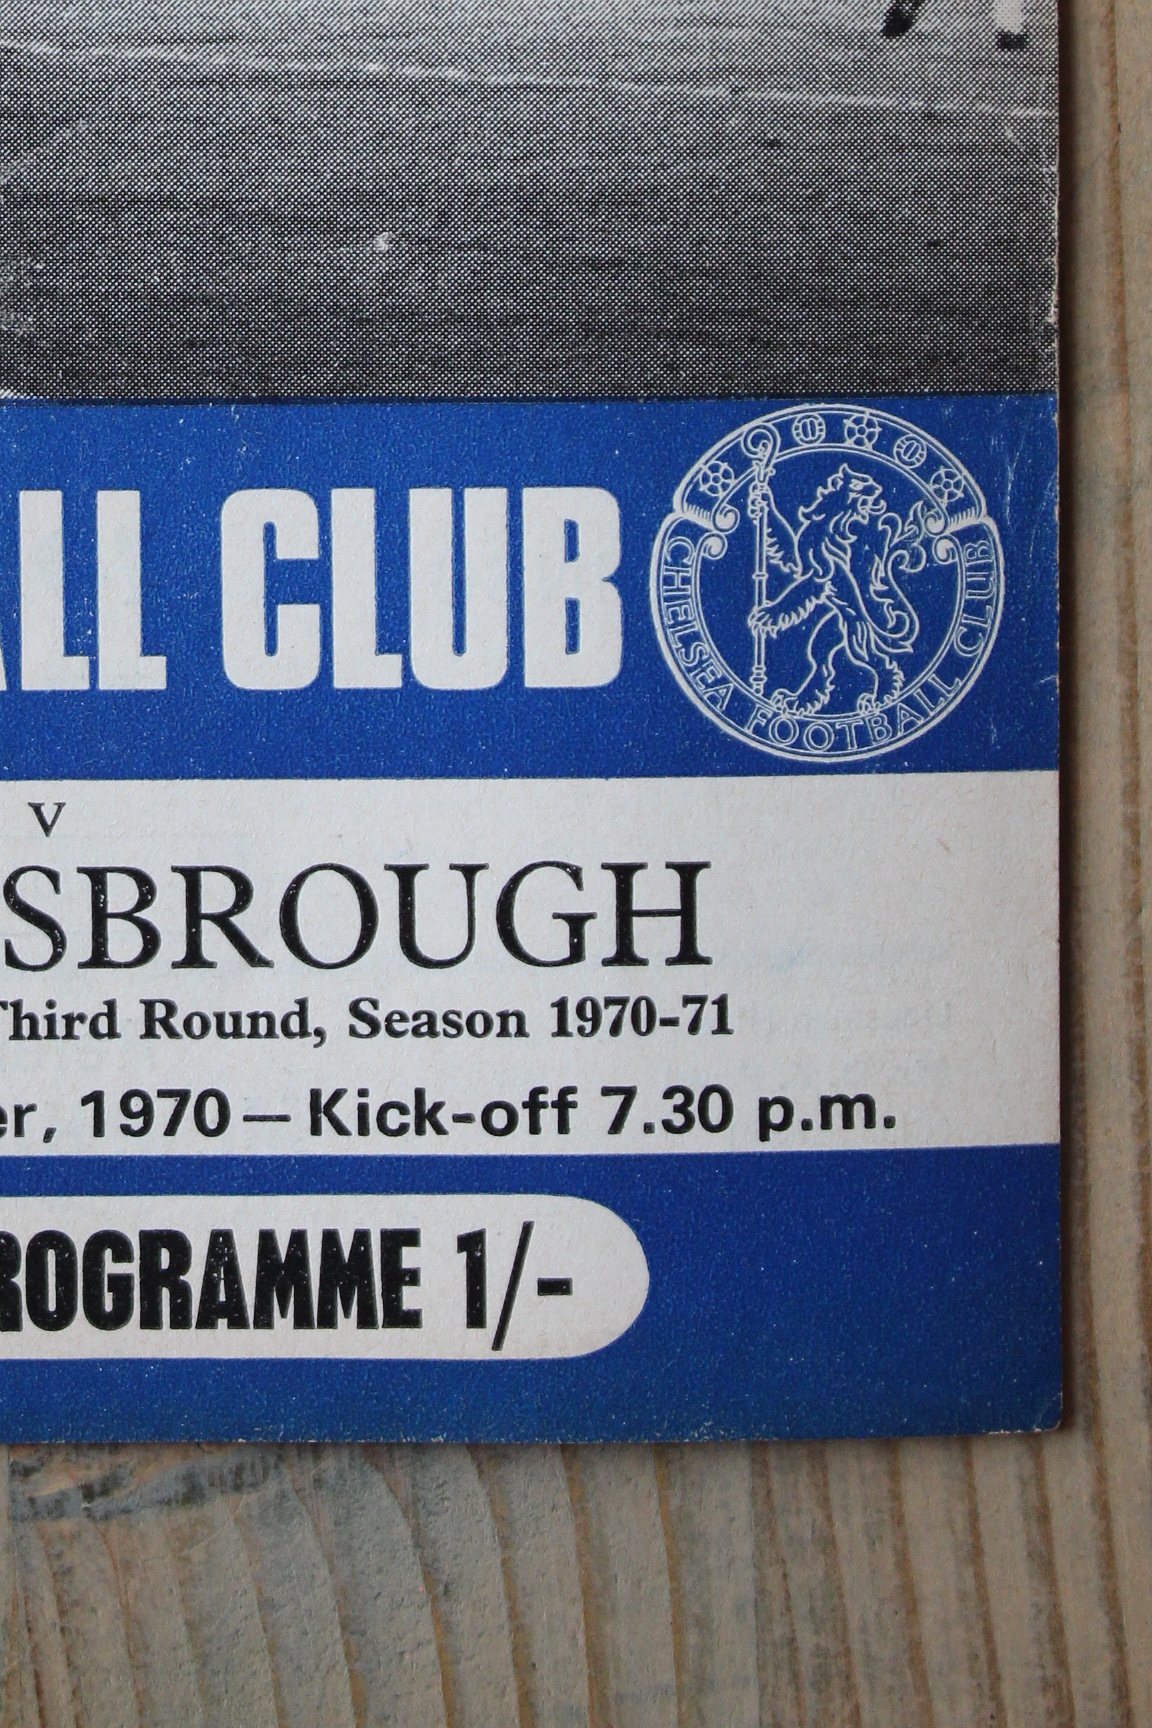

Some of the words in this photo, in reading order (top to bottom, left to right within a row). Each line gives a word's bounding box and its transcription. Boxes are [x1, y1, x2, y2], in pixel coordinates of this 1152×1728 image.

[219, 486, 624, 692] CLUB
[661, 535, 736, 712] CHELSEA
[952, 539, 995, 658] CLUB
[746, 672, 964, 752] FOOTBALL
[139, 996, 327, 1049] Round,
[348, 997, 530, 1039] Season
[550, 993, 734, 1038] 1970-71
[599, 1083, 734, 1136] 7.30
[757, 1092, 898, 1143] p.m.
[456, 1220, 574, 1353] 1/-
